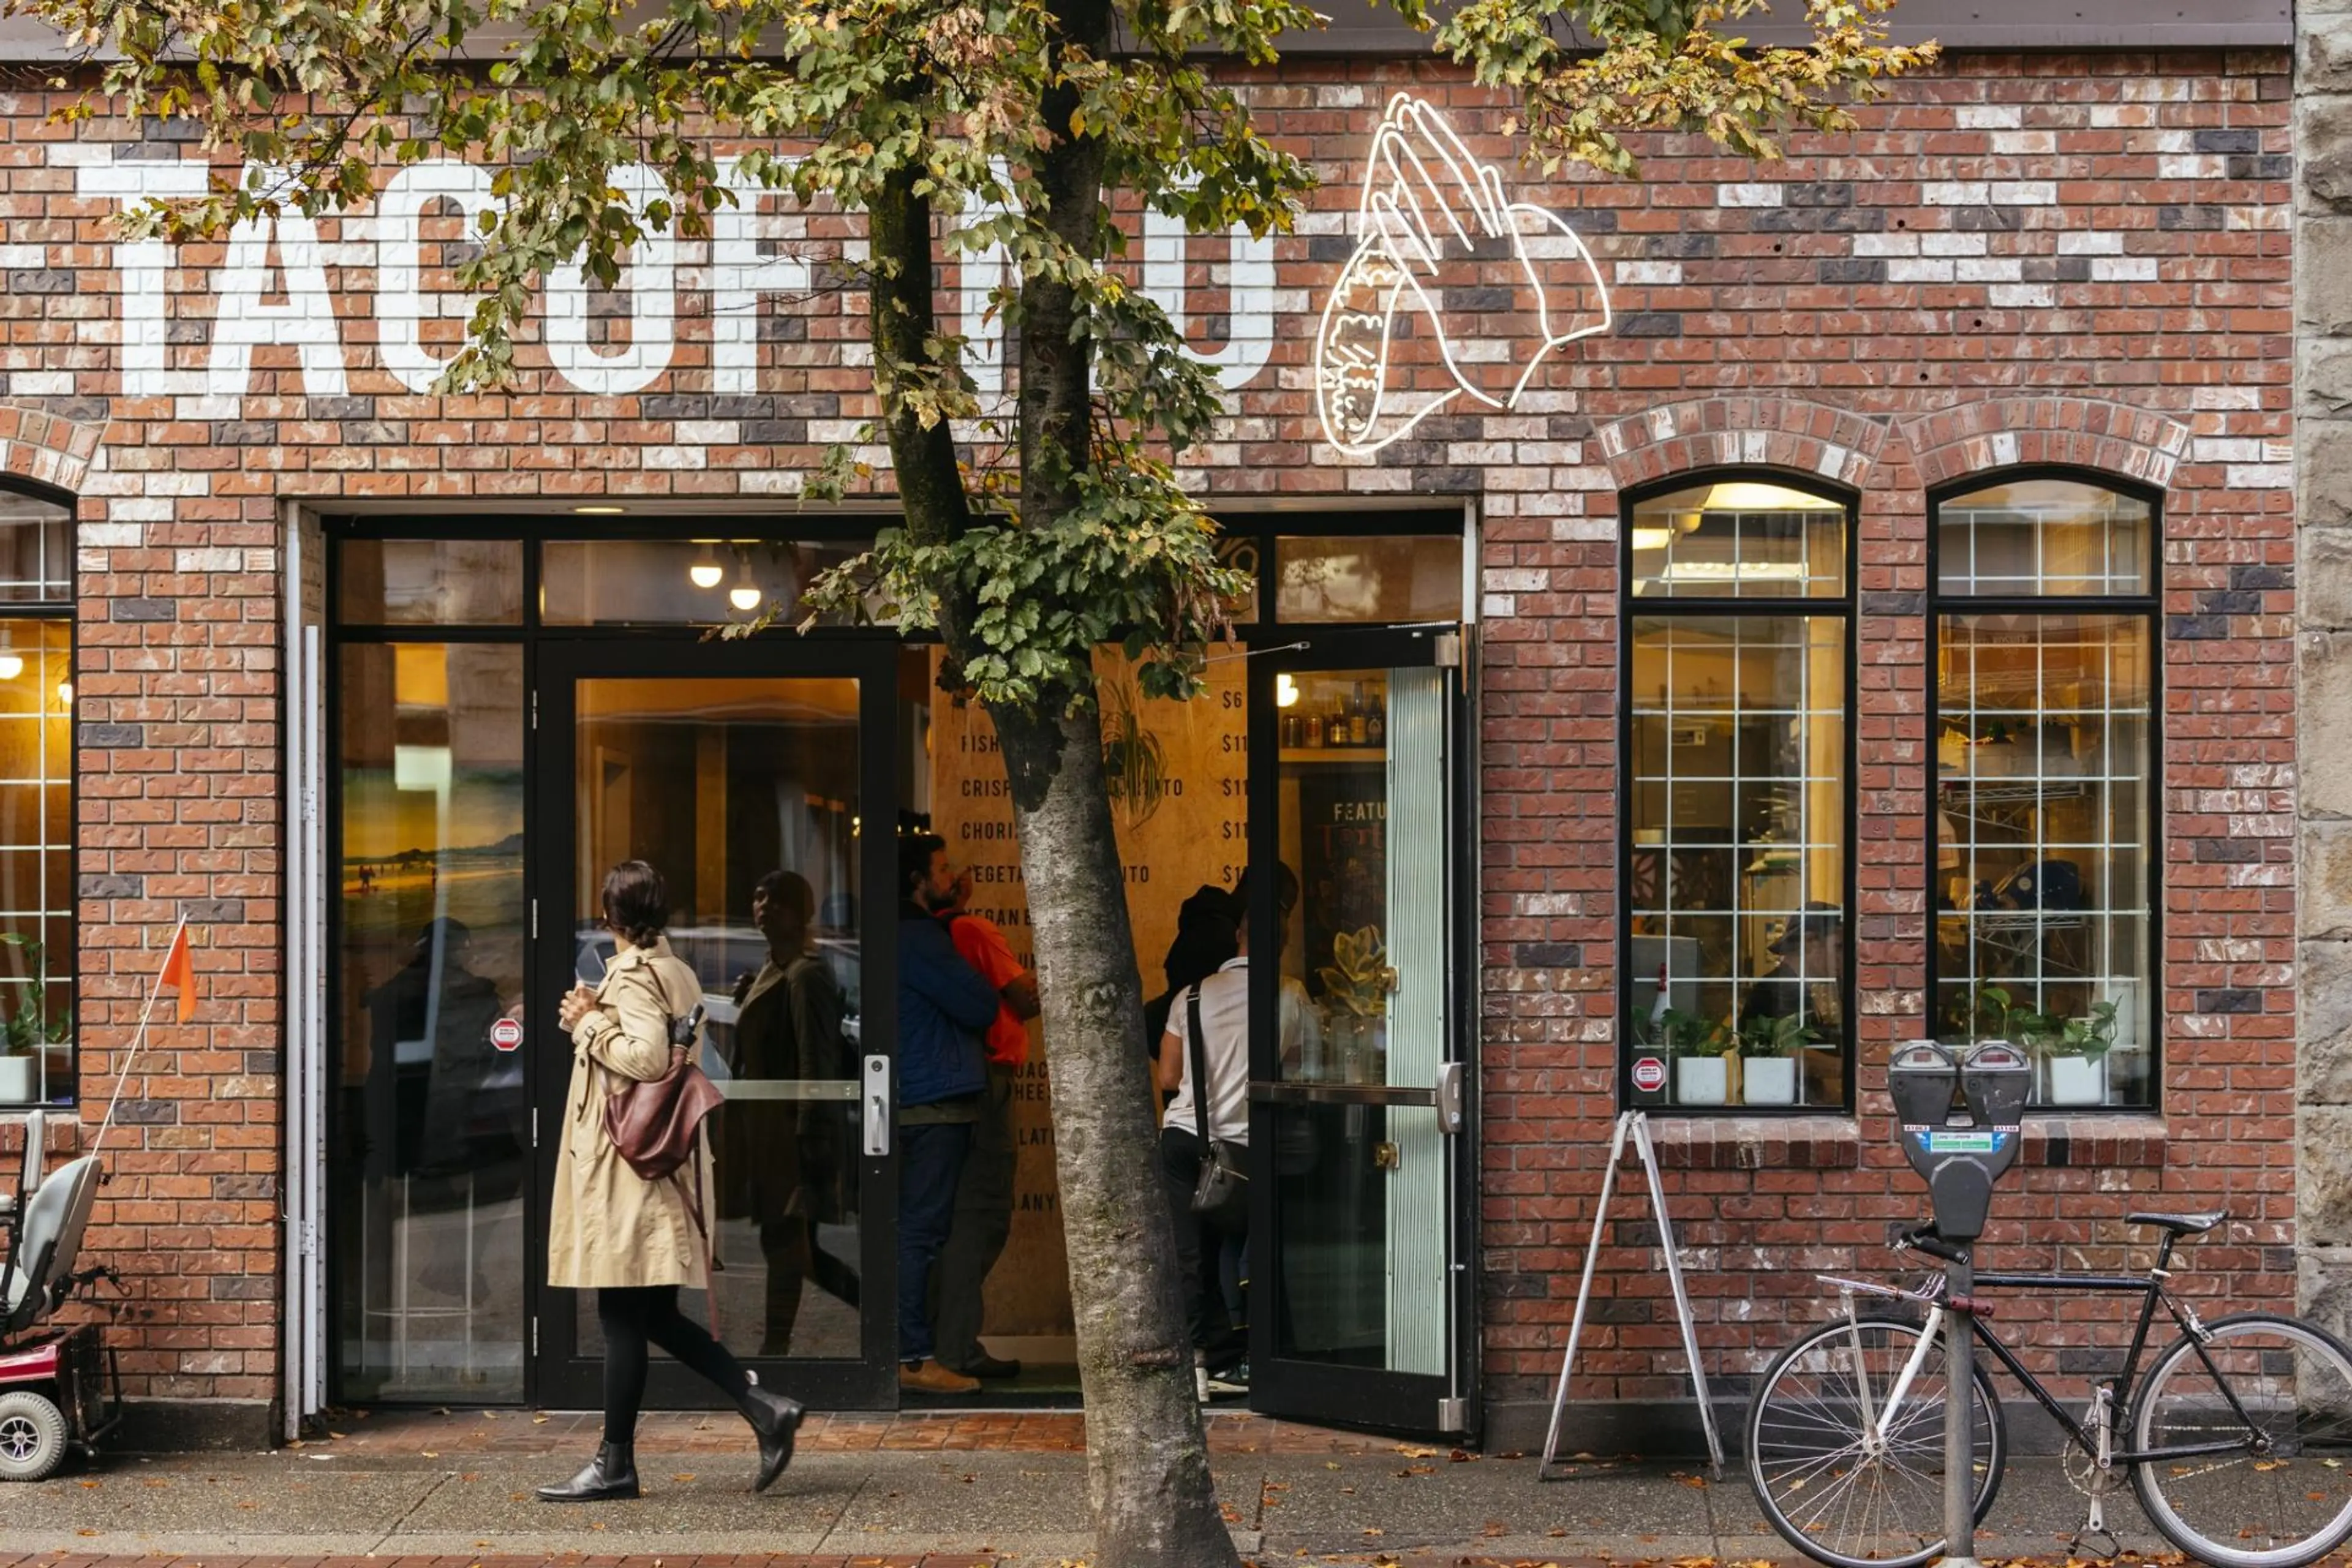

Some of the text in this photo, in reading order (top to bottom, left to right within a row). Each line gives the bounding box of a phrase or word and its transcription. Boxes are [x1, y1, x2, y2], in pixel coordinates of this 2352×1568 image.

[77, 156, 1273, 397] TACOFO
[1223, 690, 1242, 709] $6
[961, 735, 999, 753] FISH
[1223, 734, 1247, 753] $11
[962, 822, 1018, 840] CHORI
[971, 864, 1025, 883] EGETA
[1223, 864, 1242, 883] $1
[1021, 1193, 1055, 1211] ANY
